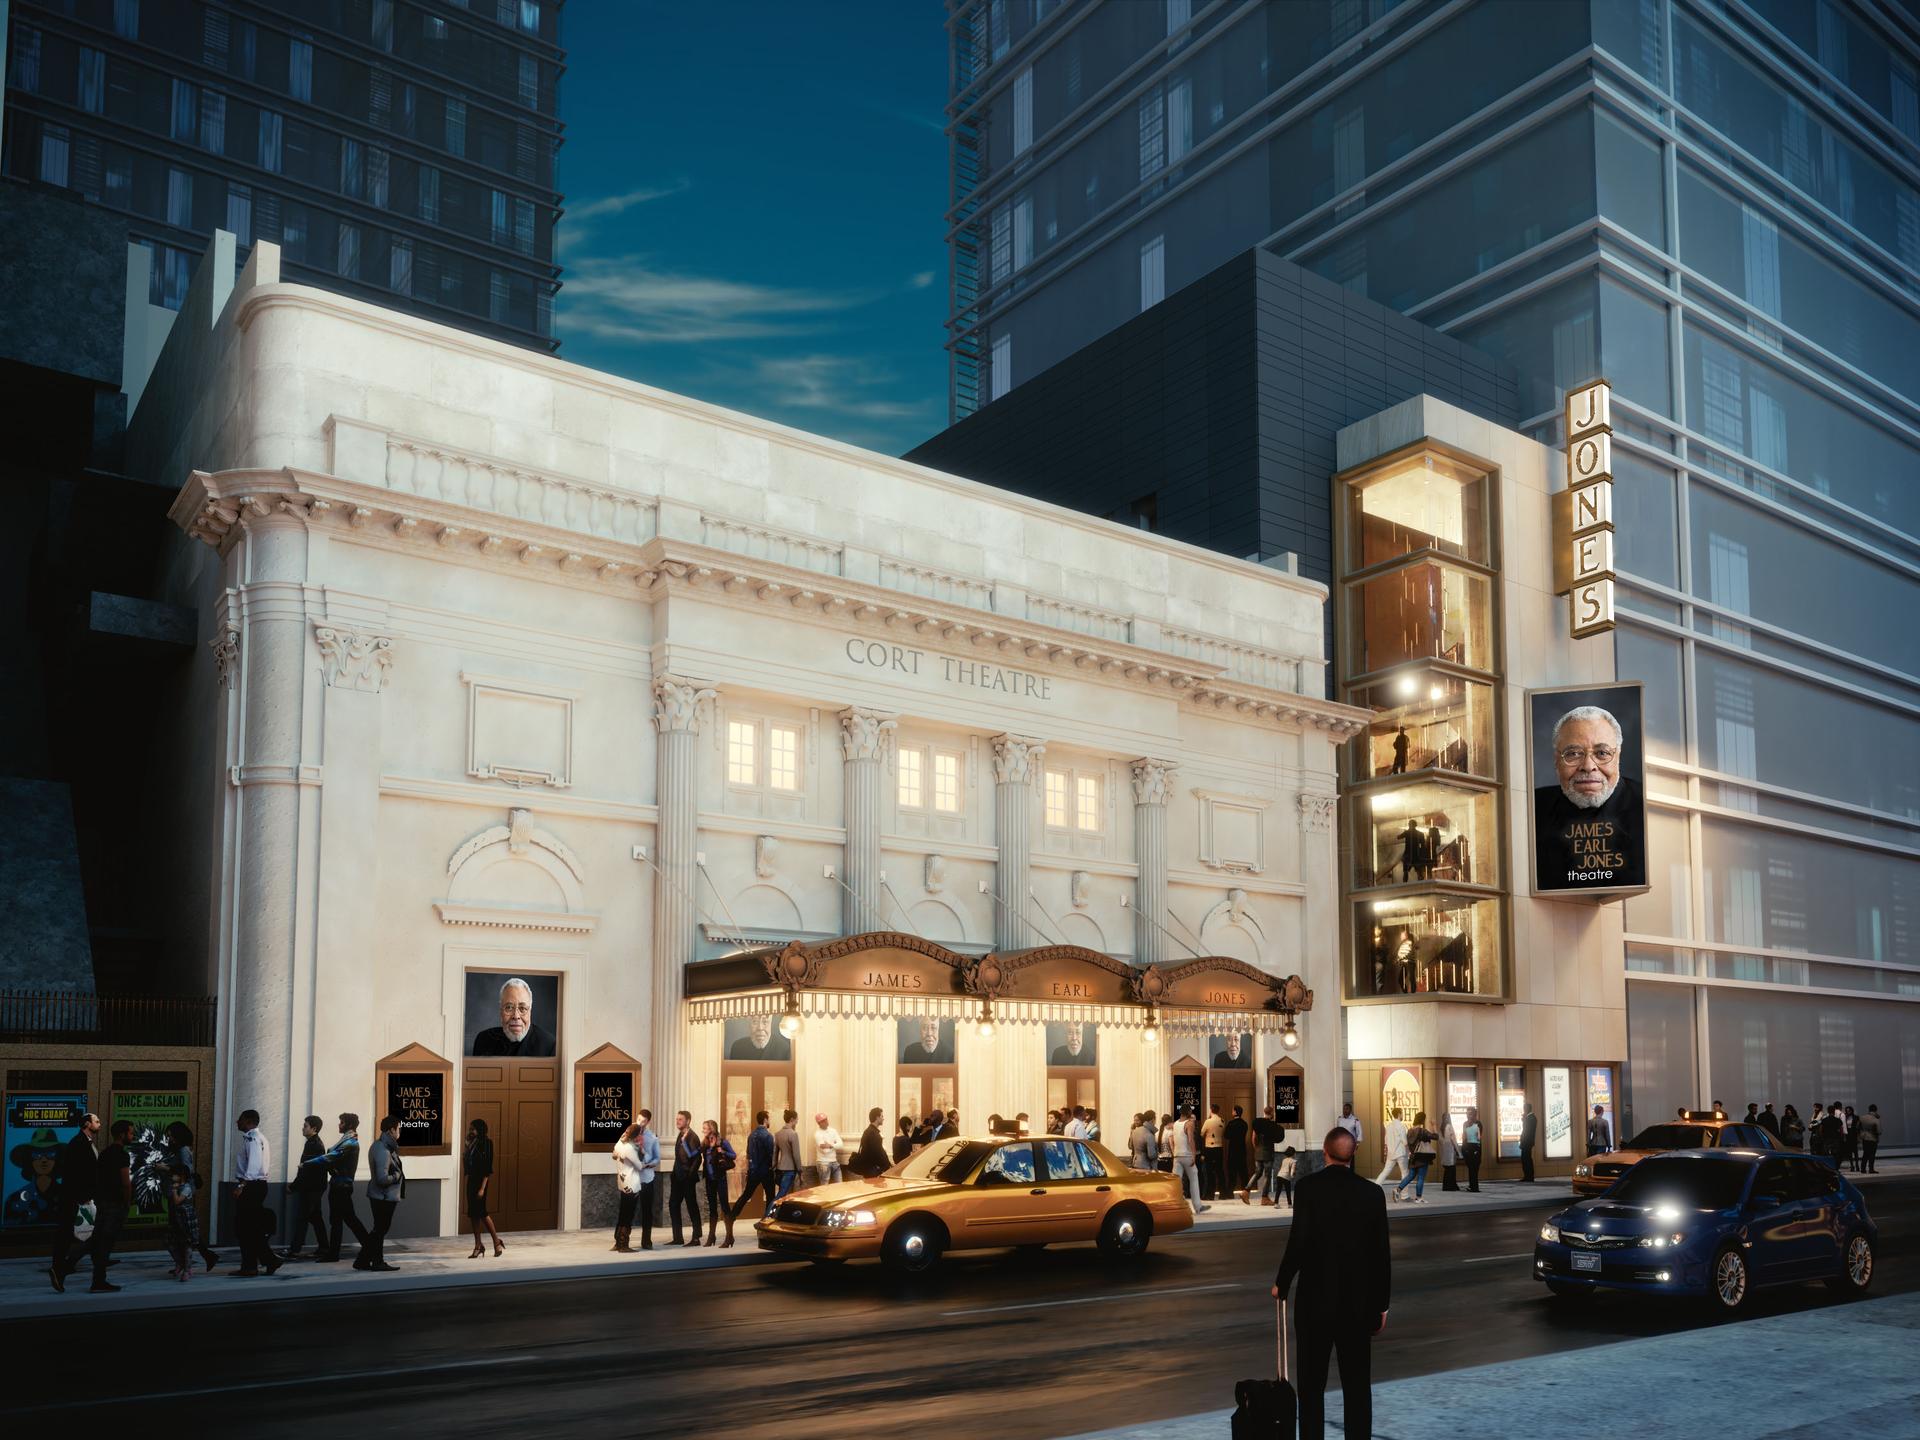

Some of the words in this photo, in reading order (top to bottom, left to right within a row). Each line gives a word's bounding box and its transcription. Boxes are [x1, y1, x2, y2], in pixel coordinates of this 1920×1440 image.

[1576, 389, 1600, 623] JONES
[846, 638, 924, 674] CORT
[939, 656, 1051, 700] THEATRE
[1565, 822, 1614, 838] JAMES
[1574, 839, 1611, 853] EARL
[1578, 853, 1624, 869] JONES
[1567, 868, 1613, 882] theatre
[863, 972, 922, 989] JAMES
[1053, 983, 1092, 998] EARL
[1205, 991, 1246, 1006] JONES
[396, 1086, 431, 1098] JAMES
[588, 1086, 623, 1098] JAMES
[118, 1095, 142, 1107] ONCE
[154, 1095, 185, 1107] ISLAND
[402, 1098, 429, 1109] EARL
[595, 1098, 621, 1109] EARL
[24, 1110, 40, 1119] NOC
[404, 1109, 438, 1120] JONES
[597, 1109, 630, 1120] JONES
[1385, 1107, 1419, 1122] NHT
[399, 1120, 430, 1128] heatre
[590, 1120, 622, 1128] theatre
